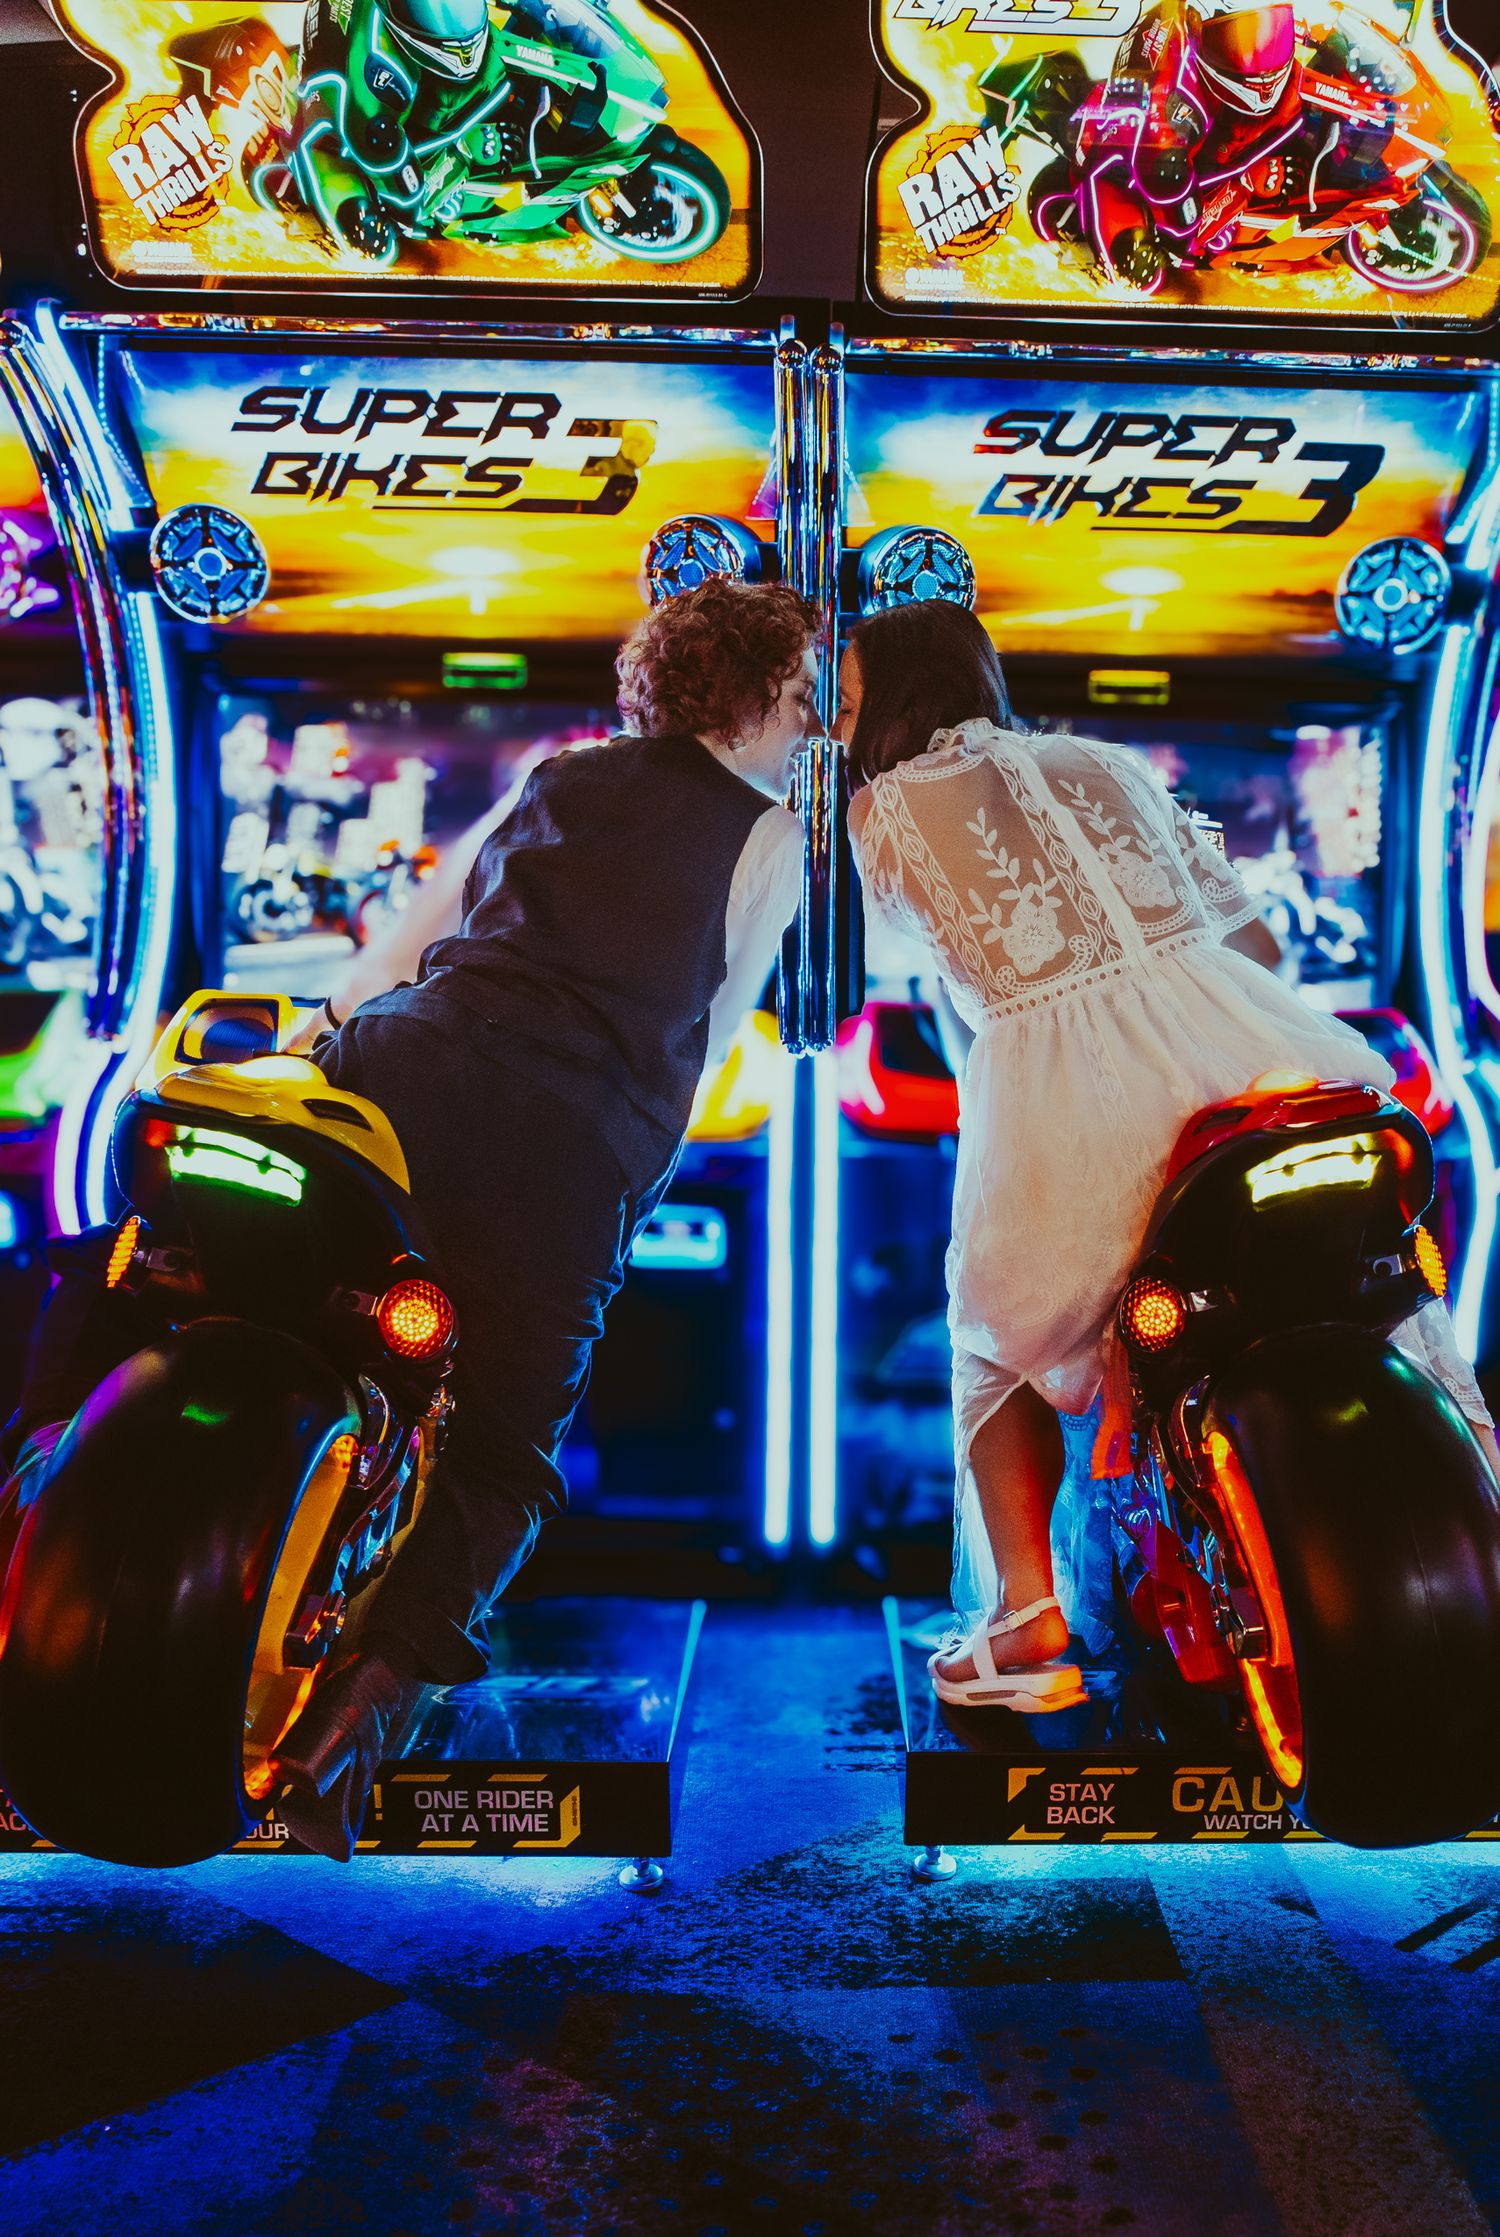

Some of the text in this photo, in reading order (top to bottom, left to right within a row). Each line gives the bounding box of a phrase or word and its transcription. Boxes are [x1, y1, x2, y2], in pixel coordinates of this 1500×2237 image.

[516, 45, 555, 68] YAMAHA
[1316, 82, 1350, 104] YAMAHA
[107, 95, 214, 200] RAW
[133, 141, 233, 226] THRILLS
[898, 125, 1007, 228] RAW
[915, 171, 1021, 254] THRILLS
[231, 386, 562, 444] SUPER
[974, 410, 1297, 468] SUPER
[250, 452, 533, 503] BIKES
[976, 474, 1257, 526] BIKES
[414, 1790, 554, 1809] ONE RIDER
[1049, 1783, 1115, 1802] STAY
[1172, 1775, 1284, 1813] CAU
[421, 1813, 549, 1833] AT A TIME
[1046, 1805, 1116, 1825] BACK
[1203, 1814, 1283, 1830] WATCH
